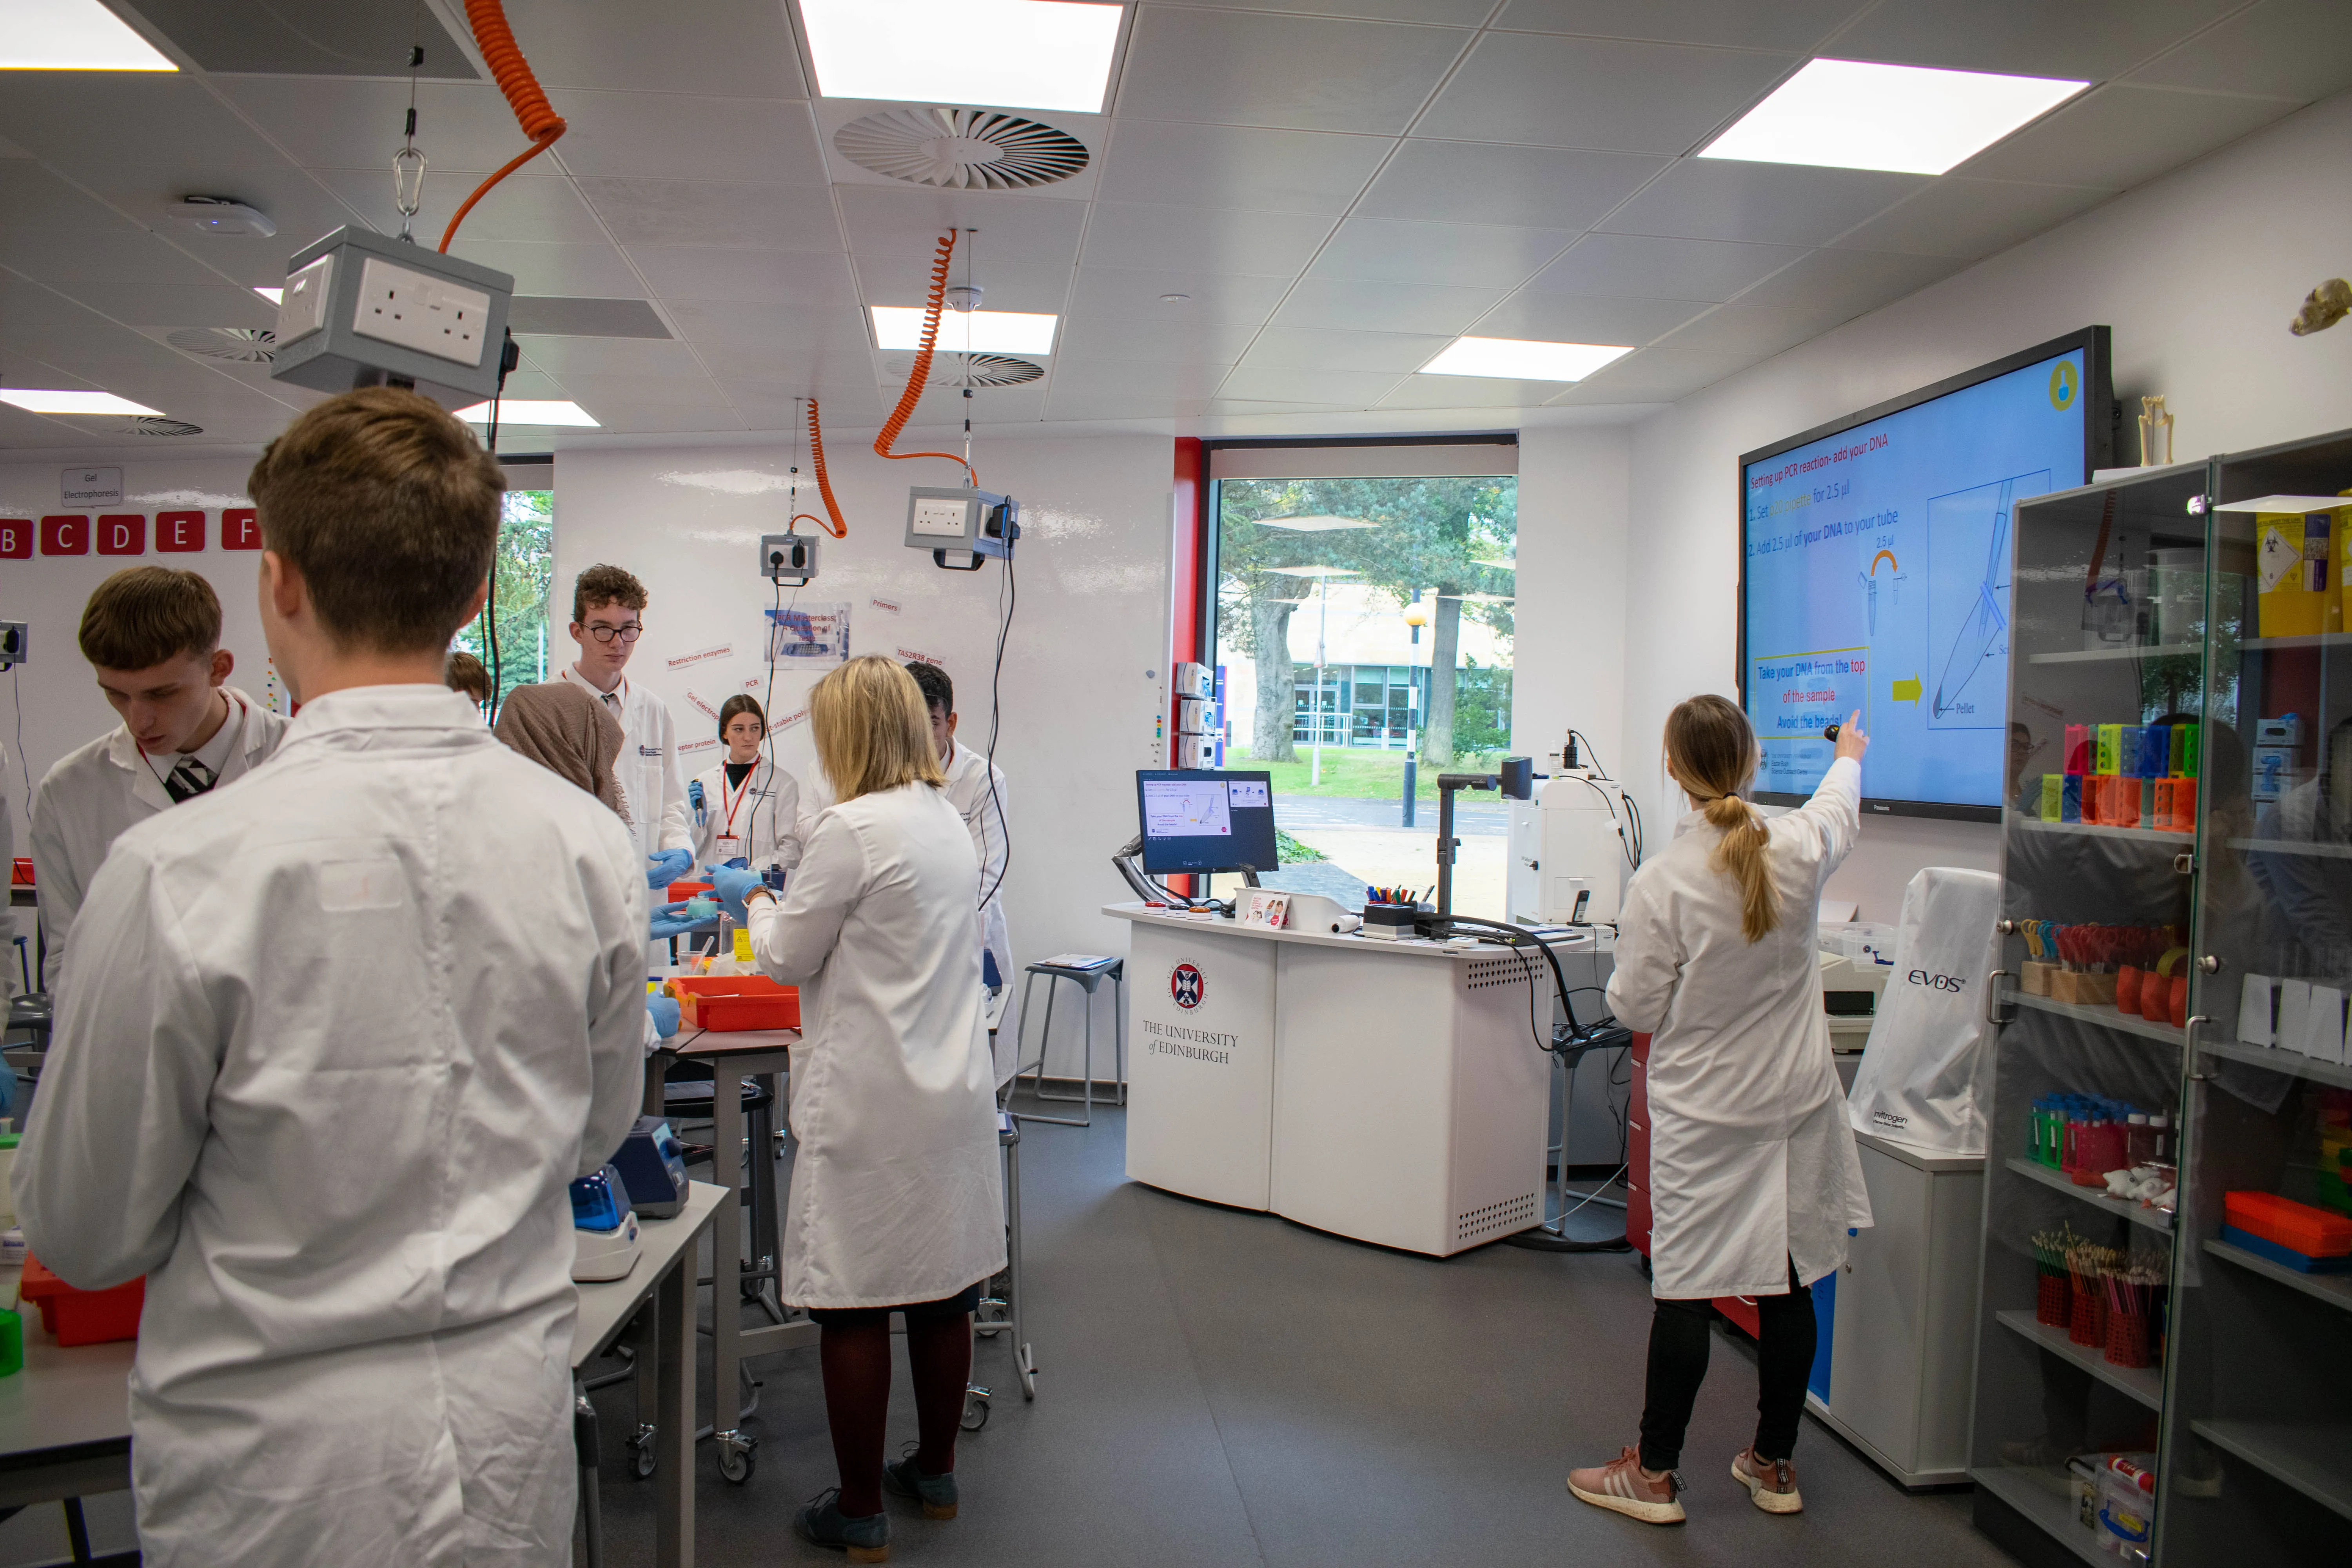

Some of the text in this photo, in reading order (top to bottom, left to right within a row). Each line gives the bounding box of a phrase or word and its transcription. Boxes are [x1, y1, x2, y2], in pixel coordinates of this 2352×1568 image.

[1751, 474, 1773, 490] Setting
[1775, 471, 1783, 484] up
[1785, 463, 1798, 479] PCR
[1833, 445, 1847, 463] add
[1849, 443, 1867, 461] your
[1869, 433, 1888, 451] DNA
[85, 474, 97, 482] Gel
[64, 489, 119, 499] Electrophoresis
[1757, 505, 1768, 519] Set
[1769, 499, 1783, 519] p20
[1785, 493, 1811, 515] pipette
[1813, 488, 1824, 504] for
[1826, 483, 1839, 500] 2.5
[2, 528, 16, 552] B
[57, 524, 73, 548] C
[113, 525, 130, 548] D
[174, 520, 188, 544] E
[240, 519, 254, 543] F
[1756, 538, 1771, 555] Add
[1772, 537, 1783, 552] 2.5
[1794, 530, 1802, 546] of
[1803, 529, 1822, 548] your
[1823, 522, 1842, 540] DNA
[1844, 521, 1853, 535] to
[1855, 517, 1875, 536] your
[1877, 508, 1898, 527] tube
[1876, 536, 1887, 549] 2.5
[873, 599, 898, 612] Primers
[668, 647, 731, 667] Restriction enzymes
[897, 649, 943, 666] TAS2R38 gene
[1758, 659, 1865, 681] Take your DNA from the top
[745, 679, 759, 688] PCR
[687, 692, 697, 702] Gel
[1783, 687, 1835, 705] of the sample
[1956, 702, 1975, 714] Pellet
[1776, 713, 1842, 729] Avoid the beads!
[695, 739, 716, 749] protein
[1176, 957, 1209, 985] UNIVERSITY
[1172, 994, 1209, 1016] EDINBURGH
[1143, 1020, 1239, 1047] THE UNIVERSITY
[1149, 1039, 1229, 1064] of EDINBURGH
